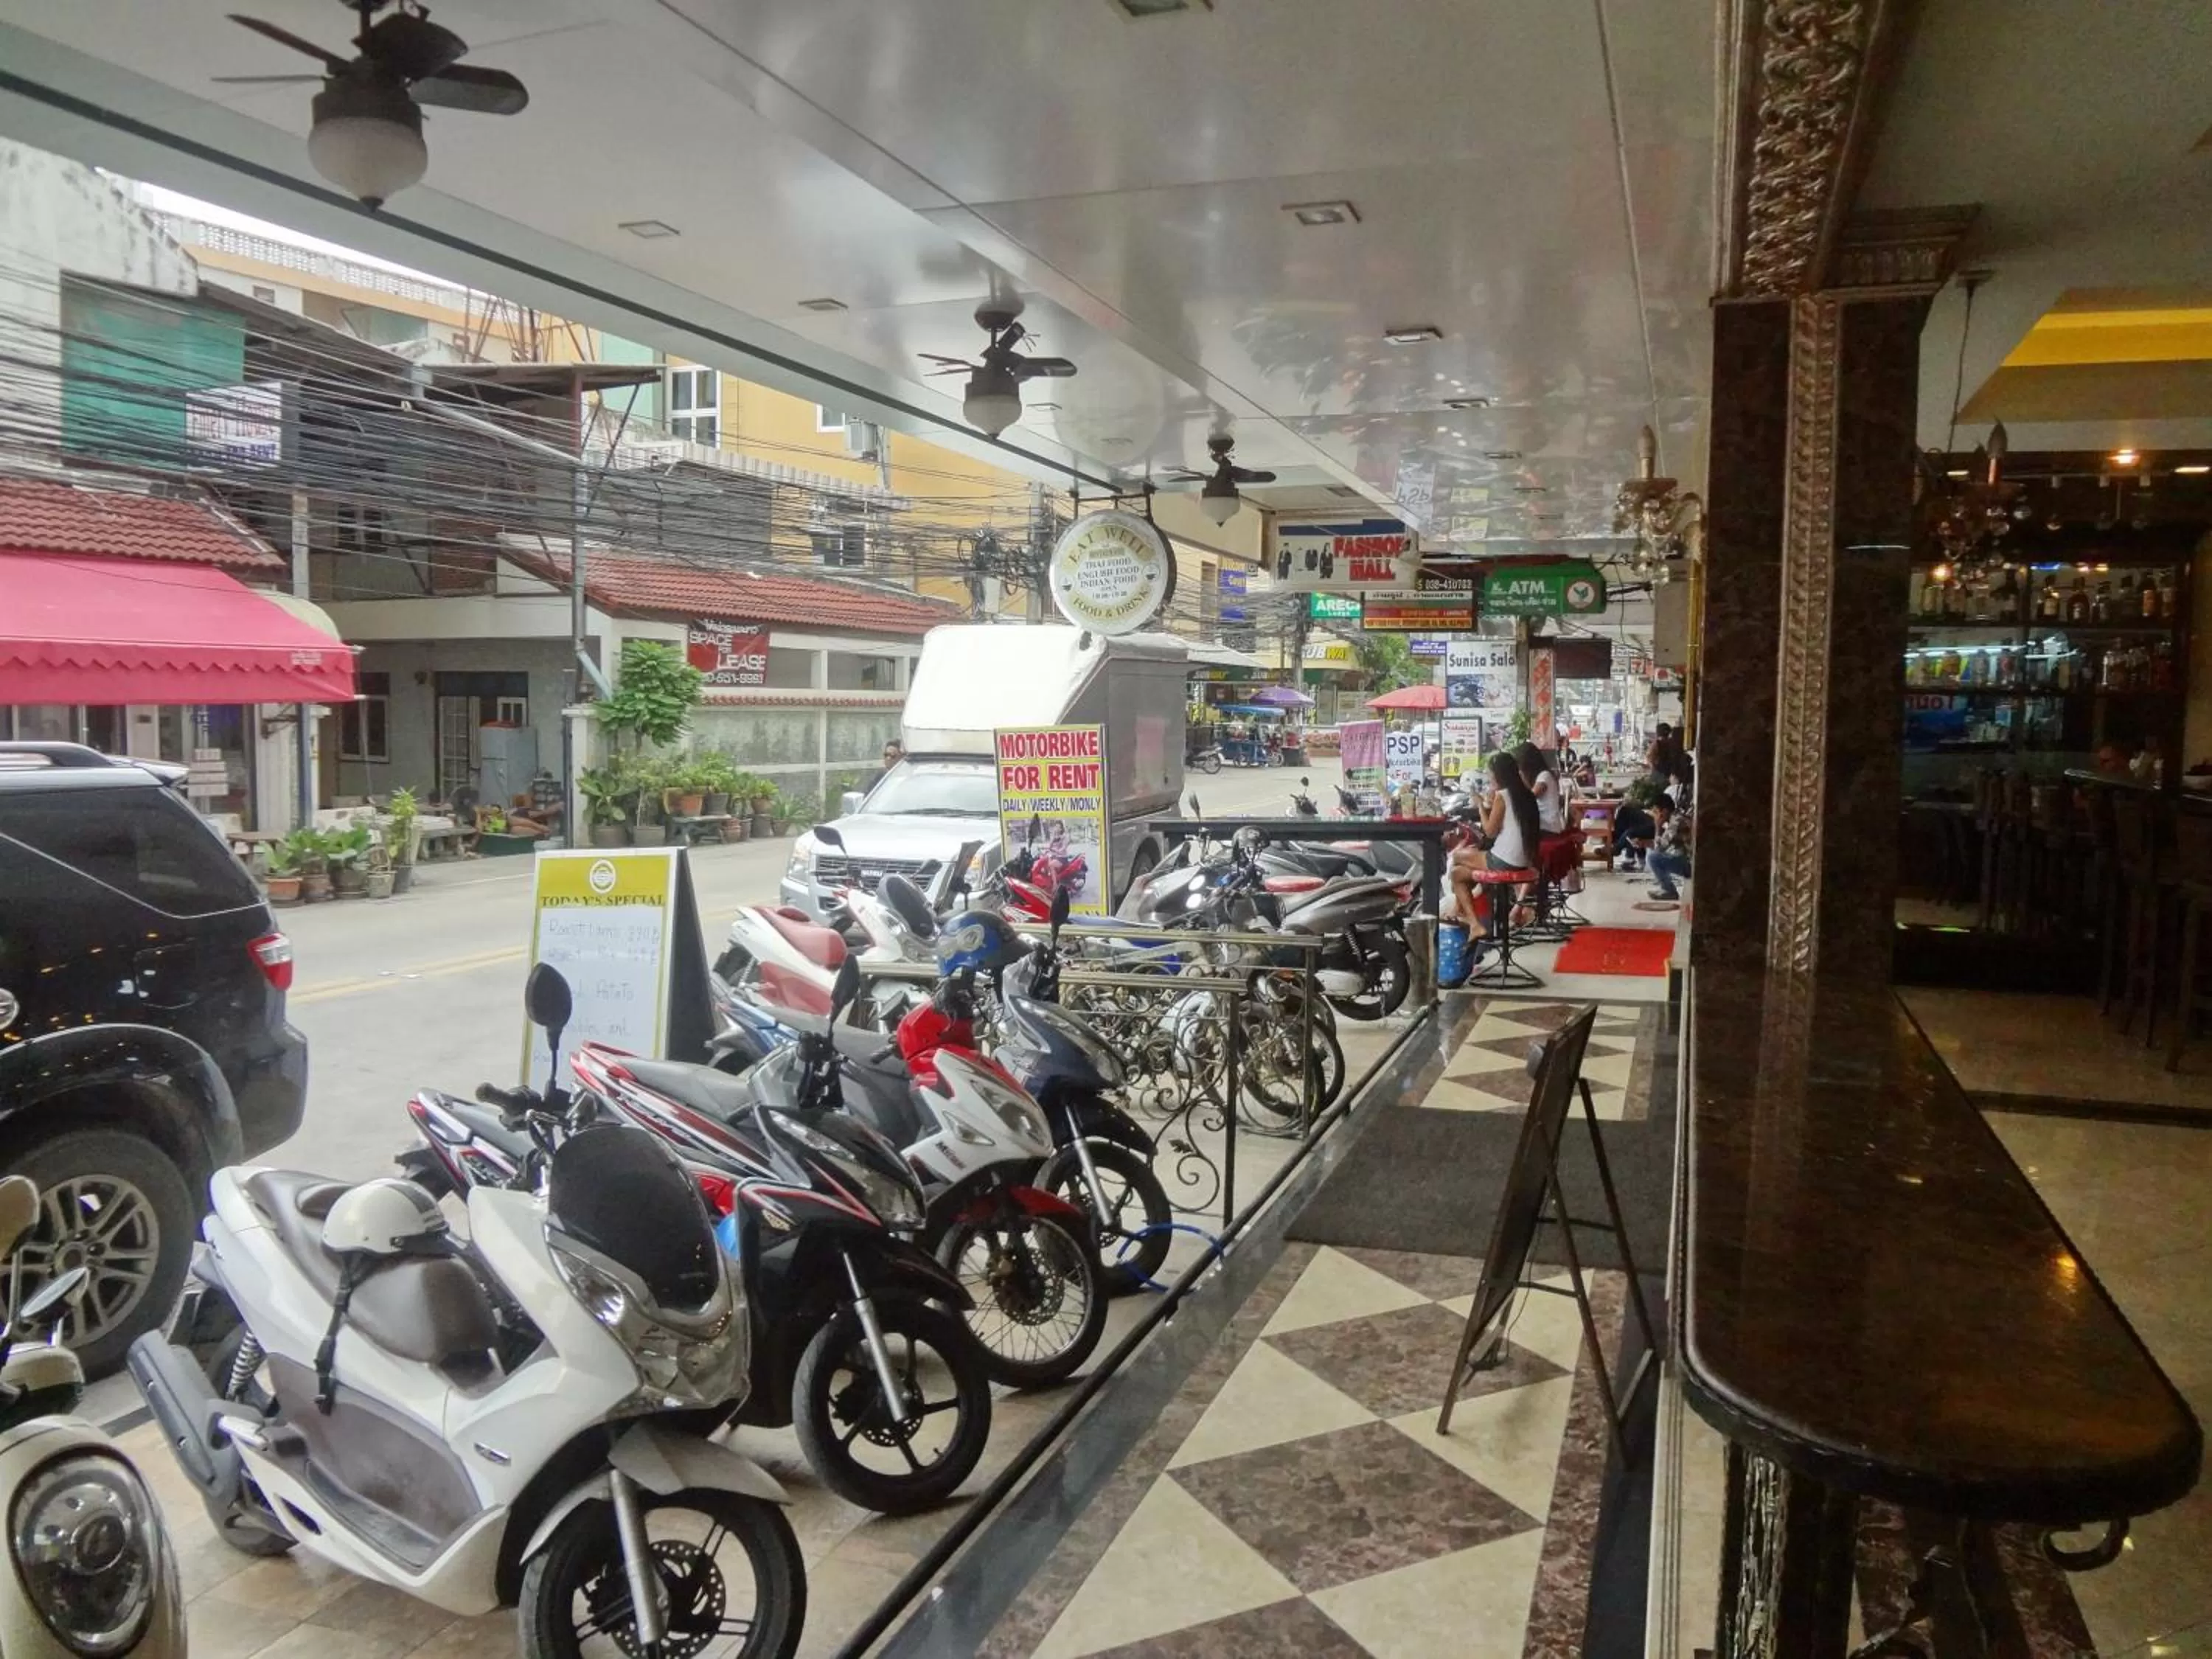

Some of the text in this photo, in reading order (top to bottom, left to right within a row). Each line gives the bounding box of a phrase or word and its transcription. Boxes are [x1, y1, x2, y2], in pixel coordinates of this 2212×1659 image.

[1068, 531, 1094, 563] EAT
[1085, 557, 1131, 570] THAI FOOD
[1351, 559, 1395, 580] MALL
[1078, 566, 1139, 580] ENGLISH FOOD
[1080, 574, 1137, 588] INDIAN FOOD
[1509, 581, 1545, 594] ATM
[1074, 597, 1102, 618] FOOD
[689, 631, 732, 647] SPACE
[717, 654, 766, 670] LEASE
[1450, 651, 1515, 667] Sunisa Salo
[999, 731, 1099, 759] MOTORBIKE
[1388, 737, 1419, 754] PSP
[1003, 763, 1099, 791] FOR RENT
[542, 894, 665, 907] TODAY'S SPECIAL
